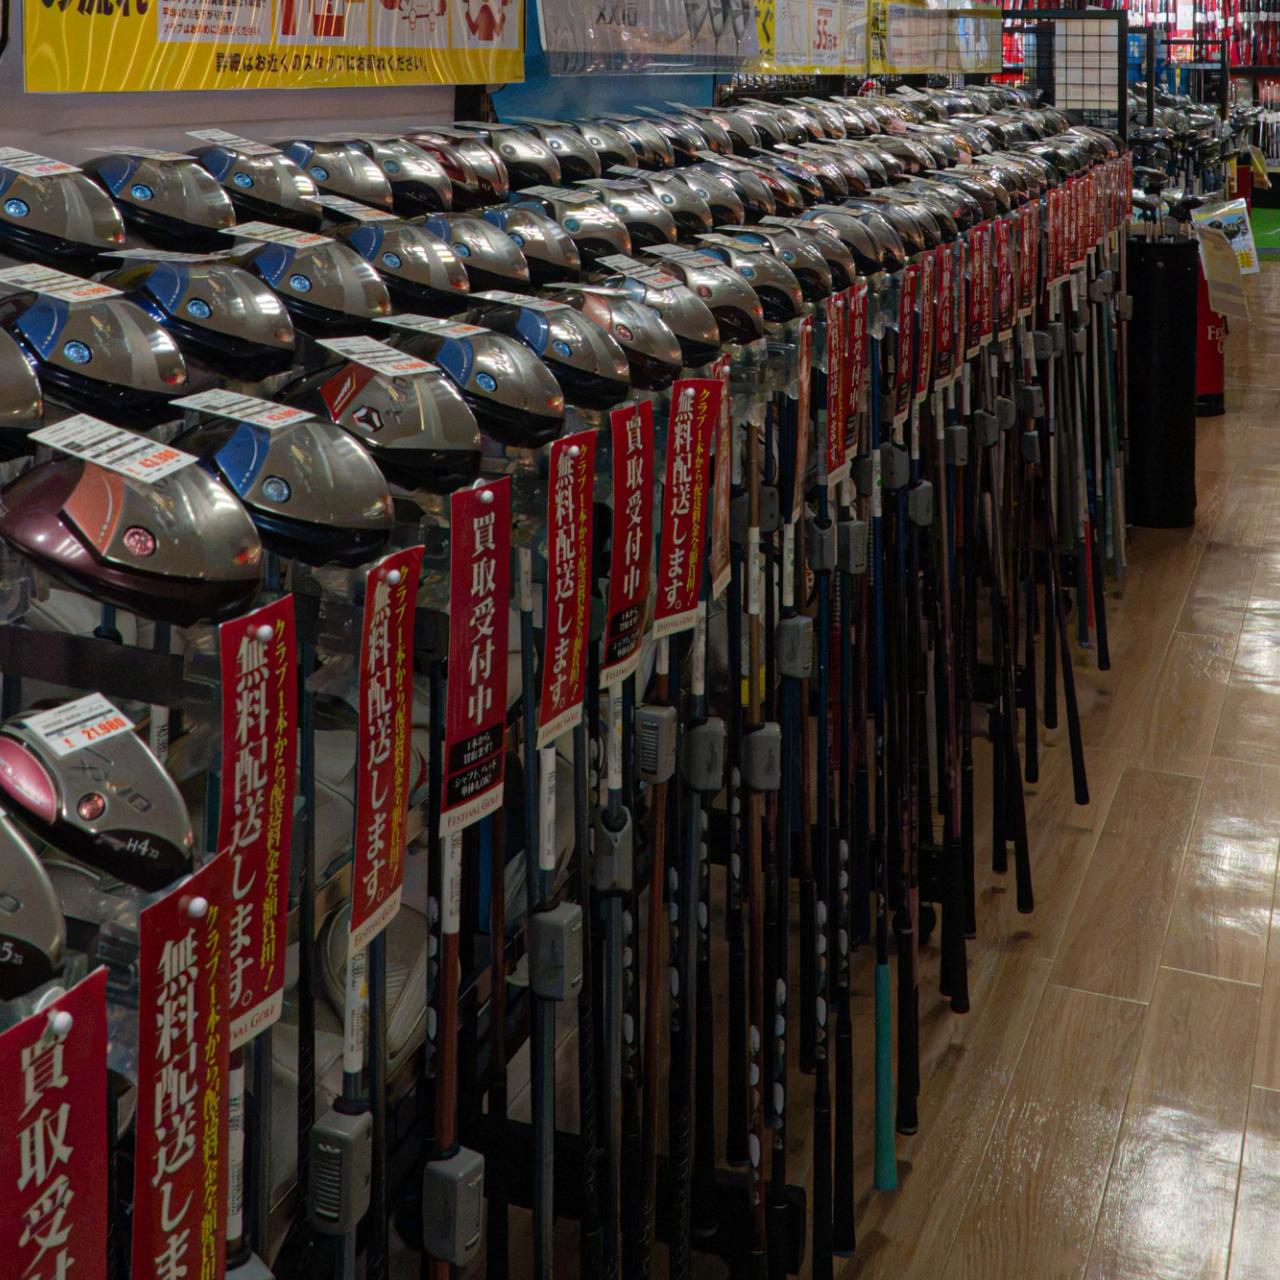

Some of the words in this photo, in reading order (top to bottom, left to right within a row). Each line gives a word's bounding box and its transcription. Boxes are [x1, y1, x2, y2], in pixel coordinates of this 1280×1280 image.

[549, 454, 575, 708] 無料配送します。
[622, 405, 644, 592] 買取受付中
[665, 389, 693, 610] 無料配送します。
[467, 511, 497, 724] 買取受付中
[127, 837, 149, 856] H4
[229, 634, 271, 1010] 無料配送します。
[363, 580, 392, 904] 無料配送します。
[447, 805, 480, 829] FESTIVAL
[480, 793, 499, 814] GOLF
